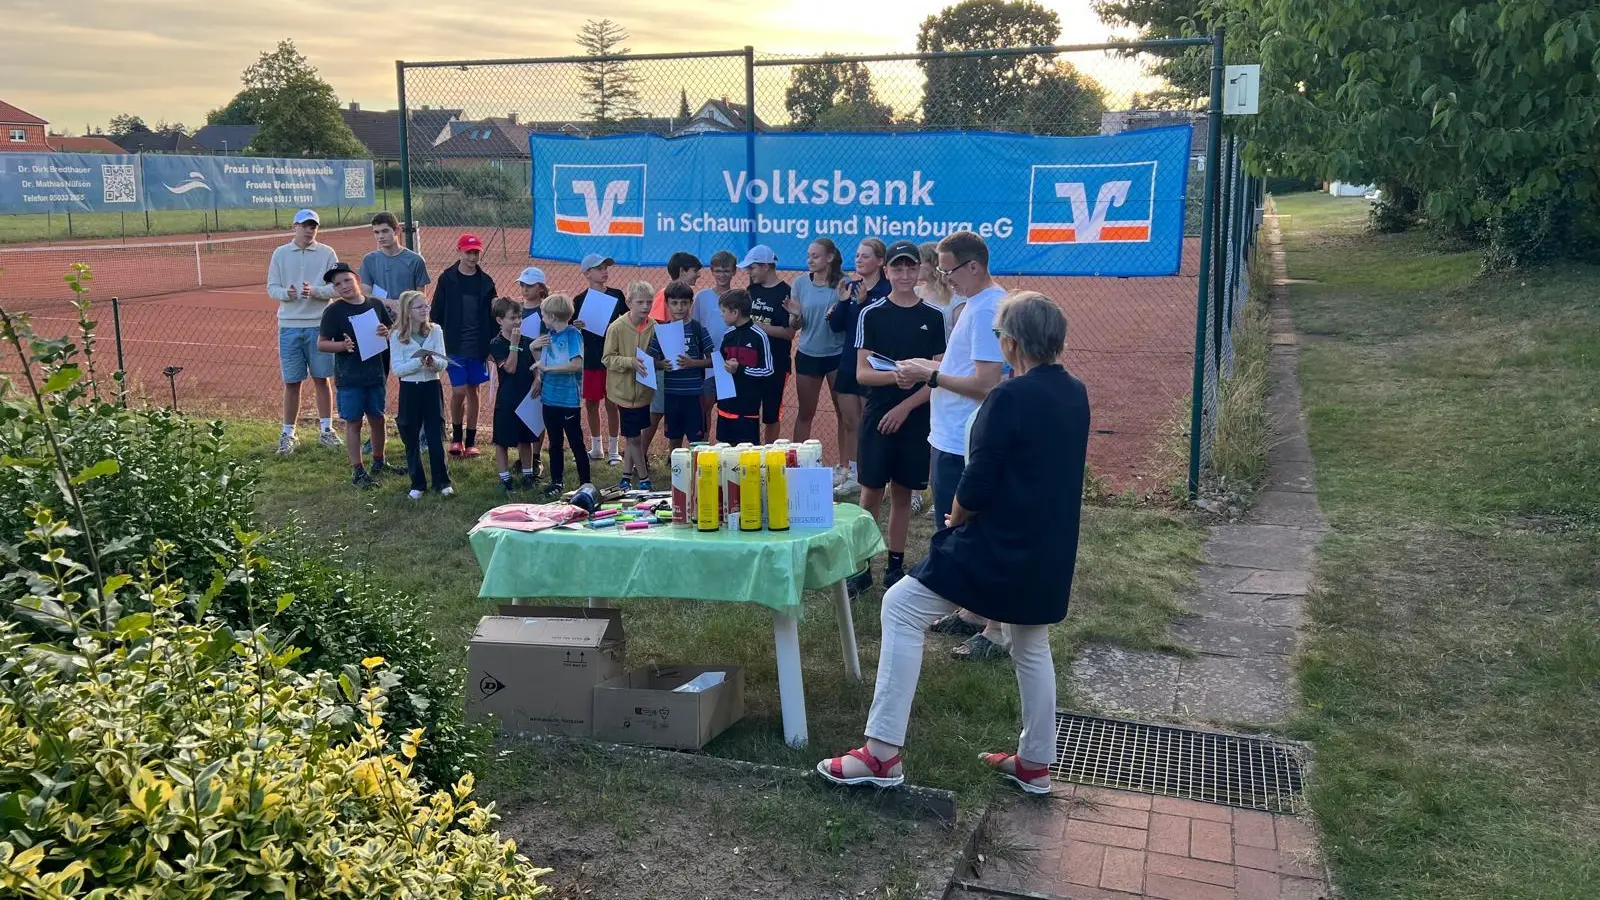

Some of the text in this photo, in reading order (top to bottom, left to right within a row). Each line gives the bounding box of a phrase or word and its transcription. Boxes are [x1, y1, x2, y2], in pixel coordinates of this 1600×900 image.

[1230, 73, 1247, 106] 1
[18, 165, 31, 173] Dr.
[32, 165, 49, 173] Dirk
[224, 164, 334, 177] Praxis für Krankengymnastik
[22, 180, 35, 188] Dr.
[36, 180, 64, 188] Mathias
[246, 181, 272, 189] Frauke
[722, 169, 935, 206] Volksbank
[23, 194, 48, 202] Telefon
[252, 195, 273, 203] Telefon
[657, 212, 675, 232] in
[680, 212, 809, 239] Schaumburg
[815, 214, 858, 235] und
[979, 217, 1013, 238] eG
